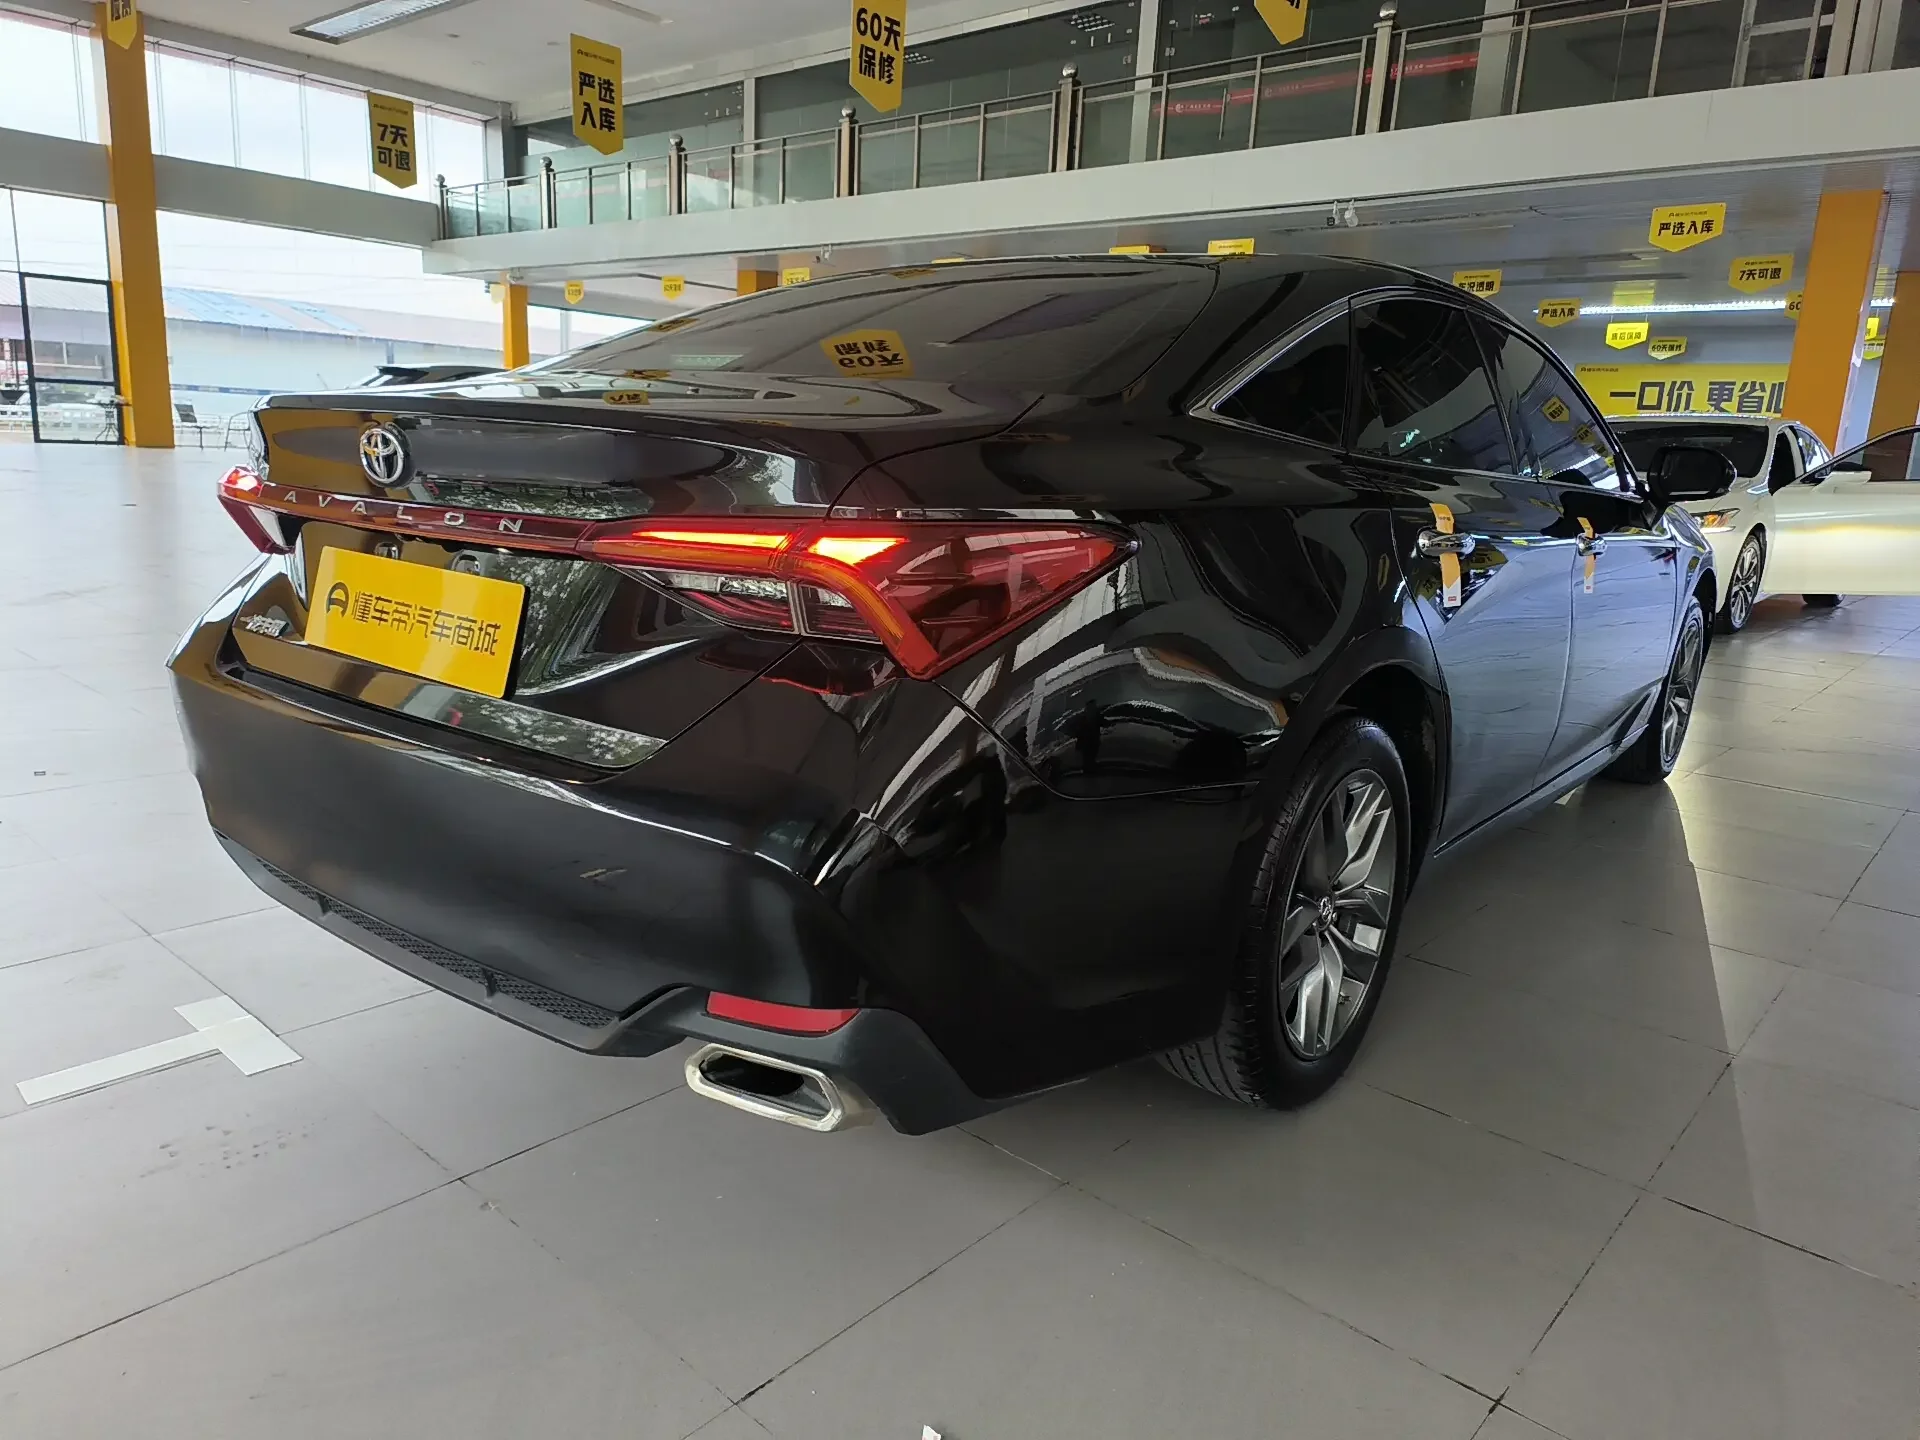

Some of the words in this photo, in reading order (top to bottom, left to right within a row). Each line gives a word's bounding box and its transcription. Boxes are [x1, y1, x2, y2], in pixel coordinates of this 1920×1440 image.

[857, 7, 901, 52] 60天
[858, 44, 896, 85] 保修
[579, 71, 615, 105] 严选
[580, 101, 616, 132] 入库
[376, 122, 408, 148] 7天
[376, 145, 411, 171] 可退
[1658, 219, 1715, 236] 严选入库
[1739, 267, 1782, 281] 7天可退
[1541, 307, 1576, 318] 严选入库
[1609, 381, 1695, 412] 一口价
[283, 490, 523, 533] AVALON
[351, 590, 502, 656] 懂车帝汽车商城
